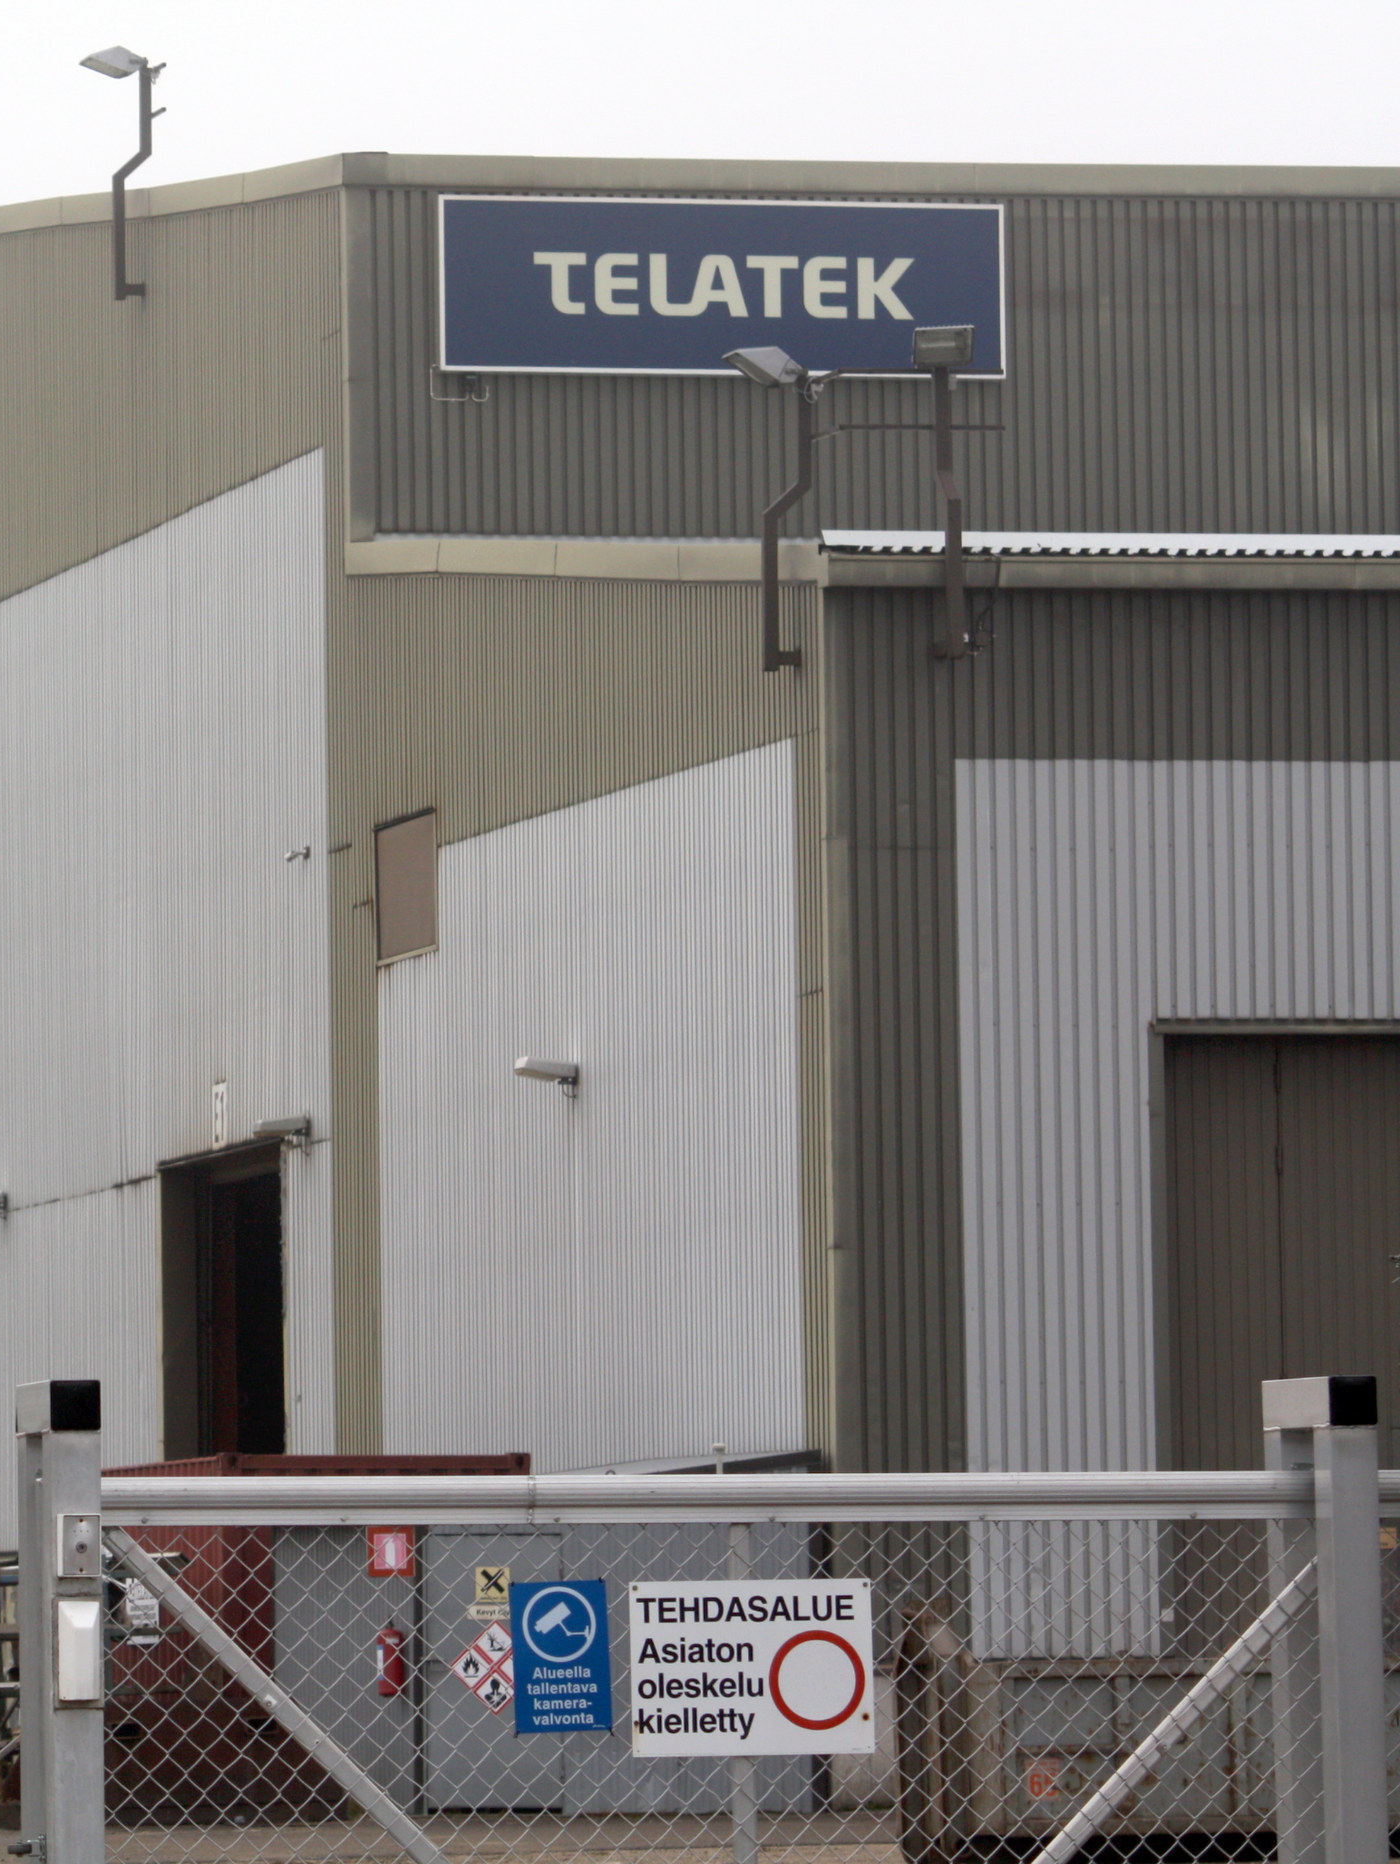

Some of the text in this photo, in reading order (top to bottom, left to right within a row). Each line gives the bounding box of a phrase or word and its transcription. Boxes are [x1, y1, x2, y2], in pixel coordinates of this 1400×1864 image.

[532, 251, 915, 320] TELATEK
[636, 1594, 855, 1623] TEHDASALUE
[638, 1636, 754, 1664] Asiaton
[532, 1665, 591, 1679] Alueella
[637, 1671, 764, 1699] oleskelu
[526, 1682, 598, 1695] tallentava
[533, 1698, 592, 1710] kamera-
[532, 1712, 594, 1726] valvonta
[638, 1707, 755, 1740] kielletty
